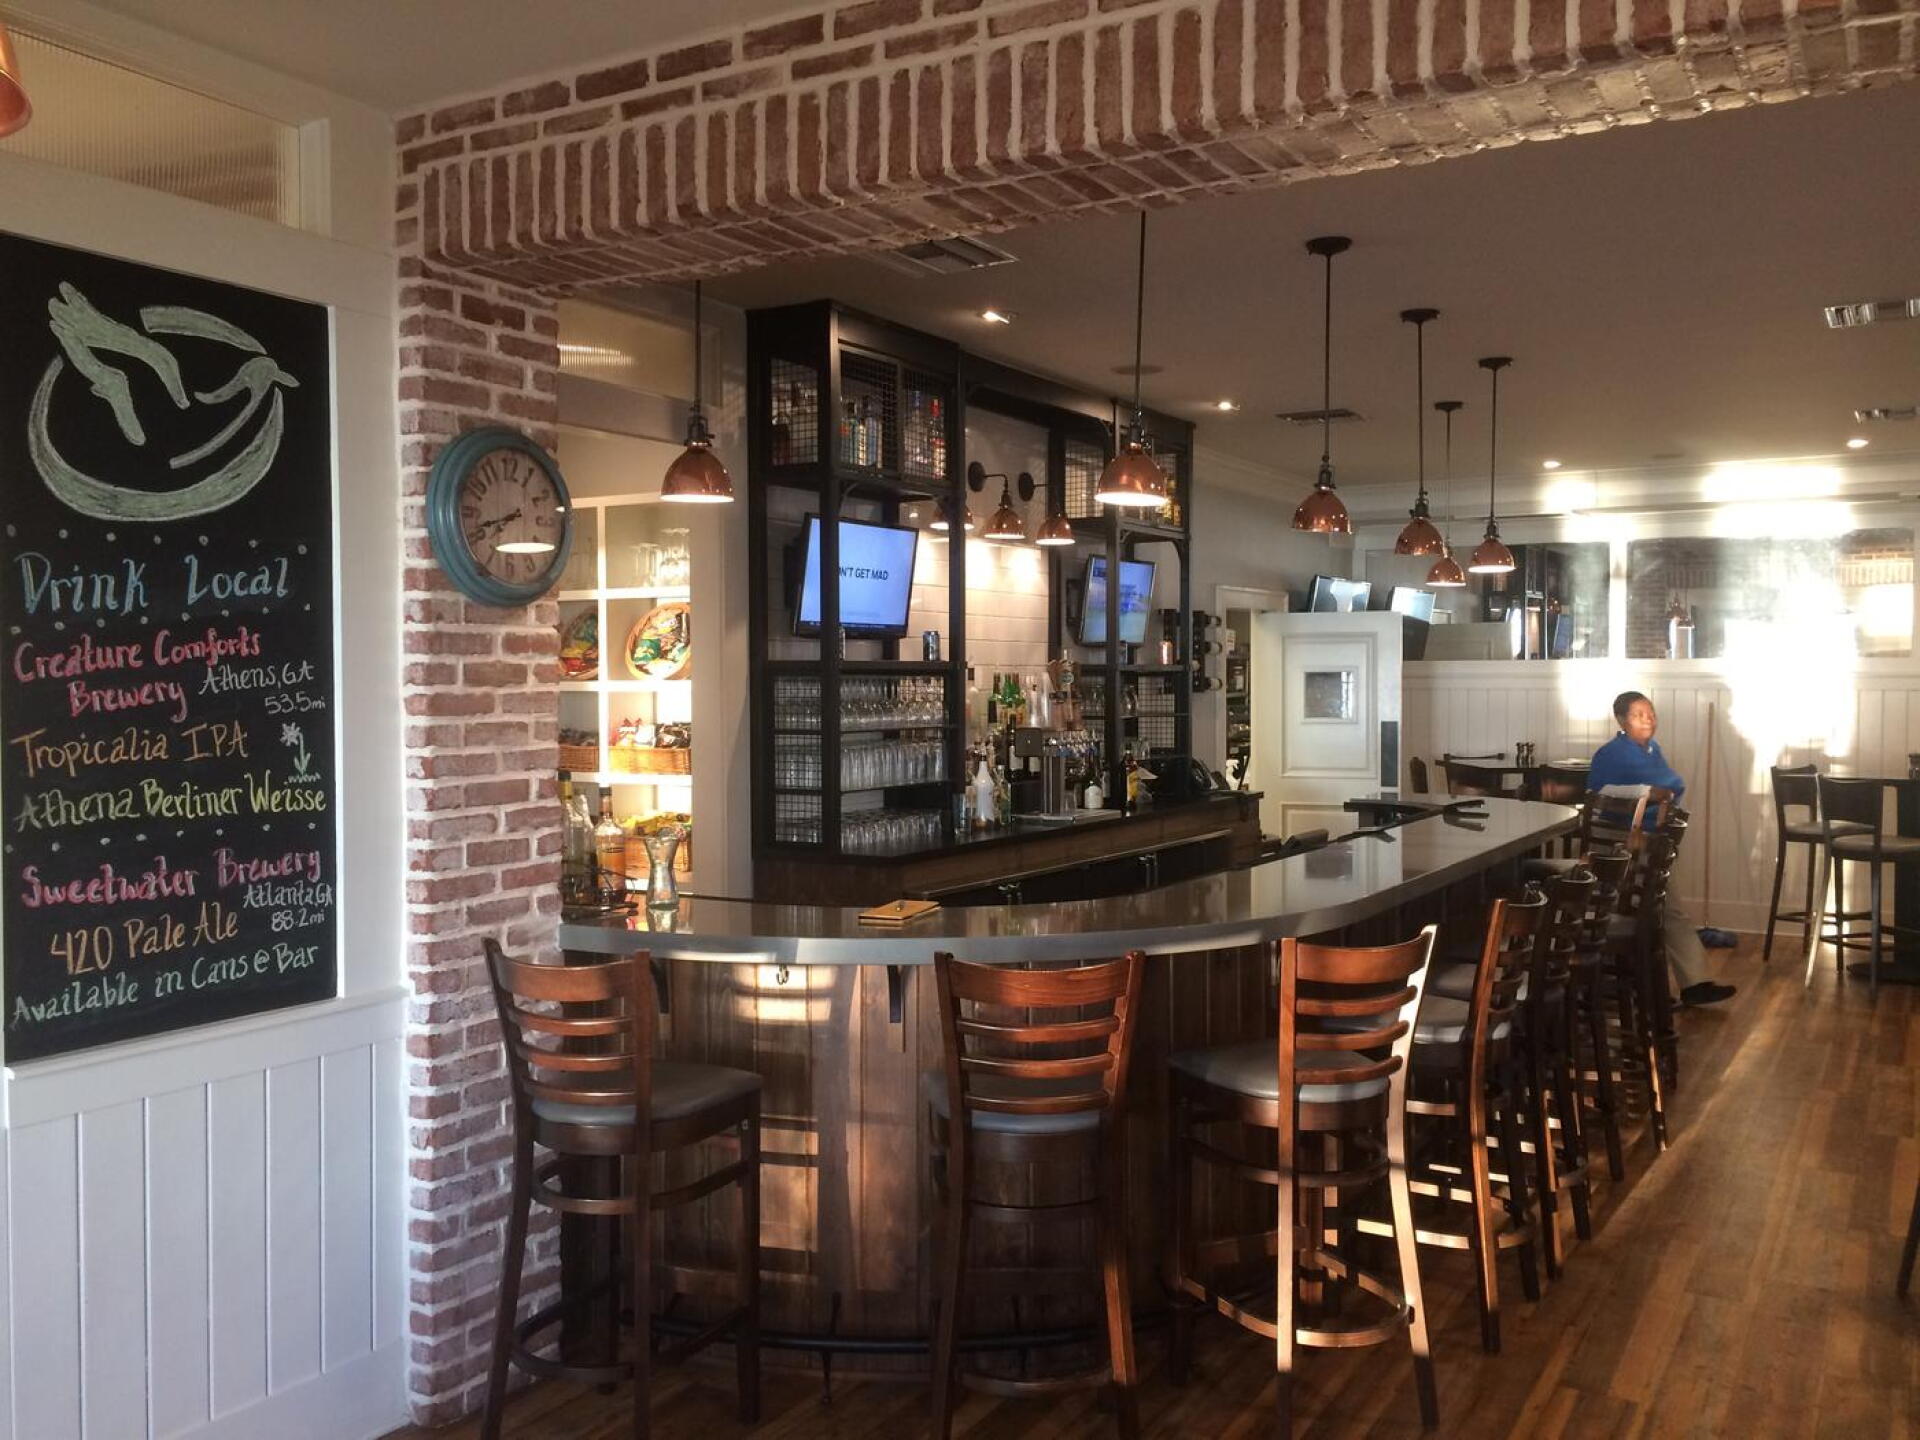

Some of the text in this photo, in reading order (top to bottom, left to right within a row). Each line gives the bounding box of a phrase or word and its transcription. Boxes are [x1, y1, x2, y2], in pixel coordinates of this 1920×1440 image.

[501, 457, 518, 484] 12
[14, 552, 289, 616] Drink Local
[855, 567, 871, 579] GET
[871, 569, 889, 581] MAD
[13, 626, 262, 683] Creature Comforts
[66, 681, 188, 723] Brewery
[10, 720, 249, 778] Tropicalia IPA
[15, 769, 327, 832] Athena Berliner Weisse
[21, 847, 322, 907] Sweetwater Brewery
[50, 901, 240, 976] 420 Pale Ale
[12, 971, 140, 1028] Available
[155, 969, 185, 998] in
